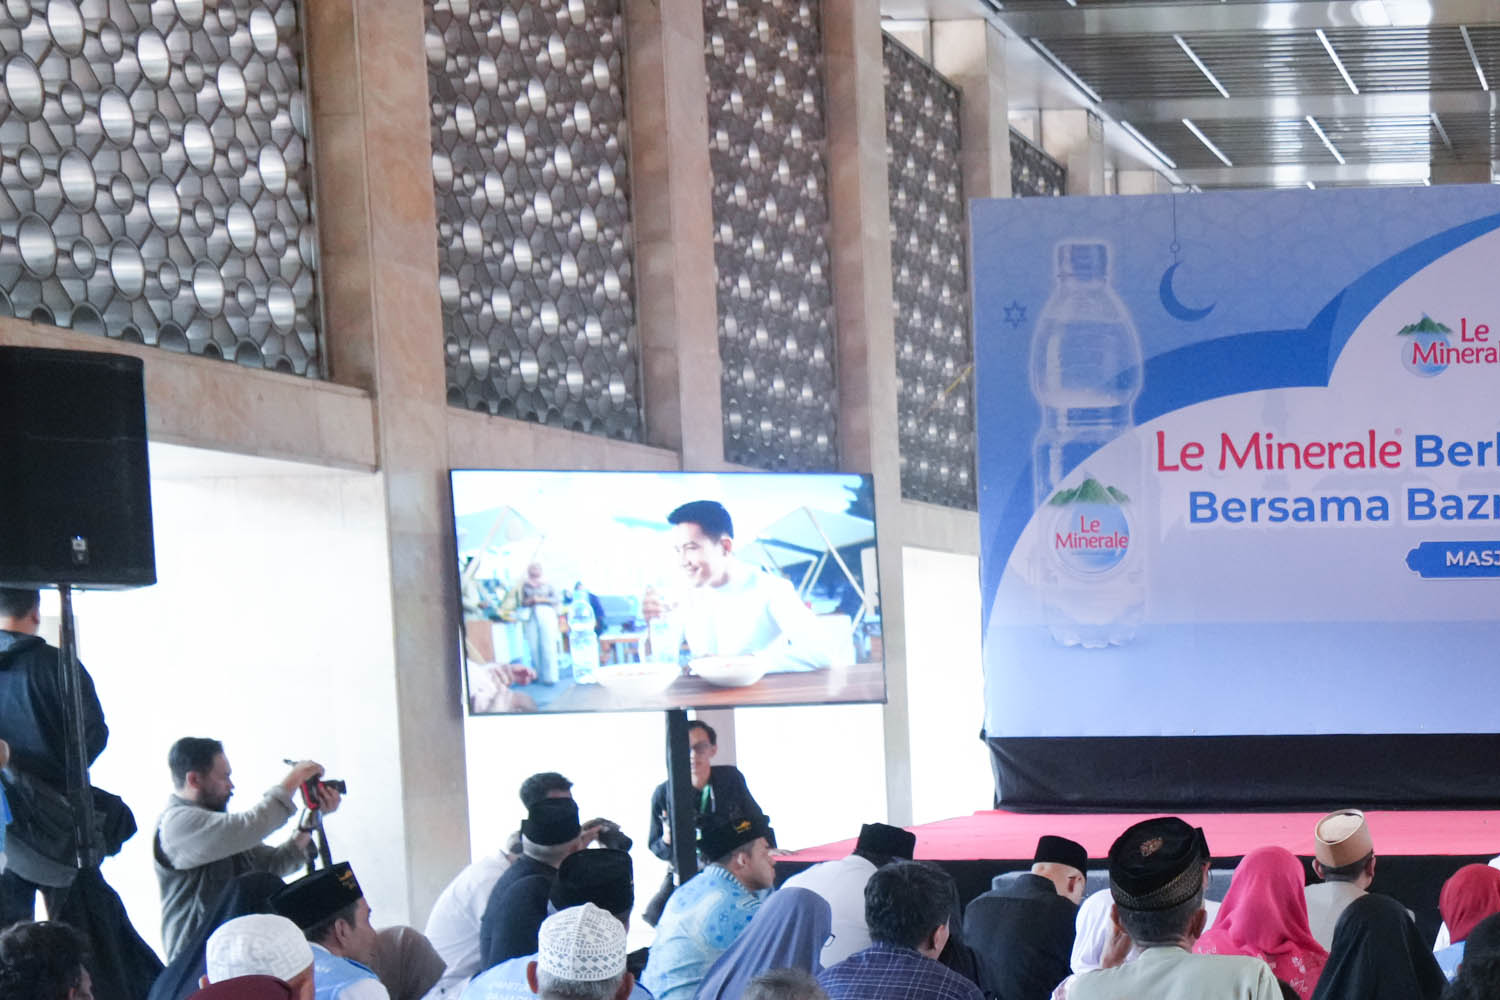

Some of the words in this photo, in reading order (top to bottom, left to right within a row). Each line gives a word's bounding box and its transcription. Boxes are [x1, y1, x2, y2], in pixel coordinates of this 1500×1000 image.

[1460, 317, 1490, 343] Le
[1156, 430, 1205, 472] Le
[1218, 428, 1402, 471] Minerale
[1189, 490, 1390, 524] Bersama
[1080, 515, 1101, 534] Le
[1055, 531, 1129, 550] Minerale
